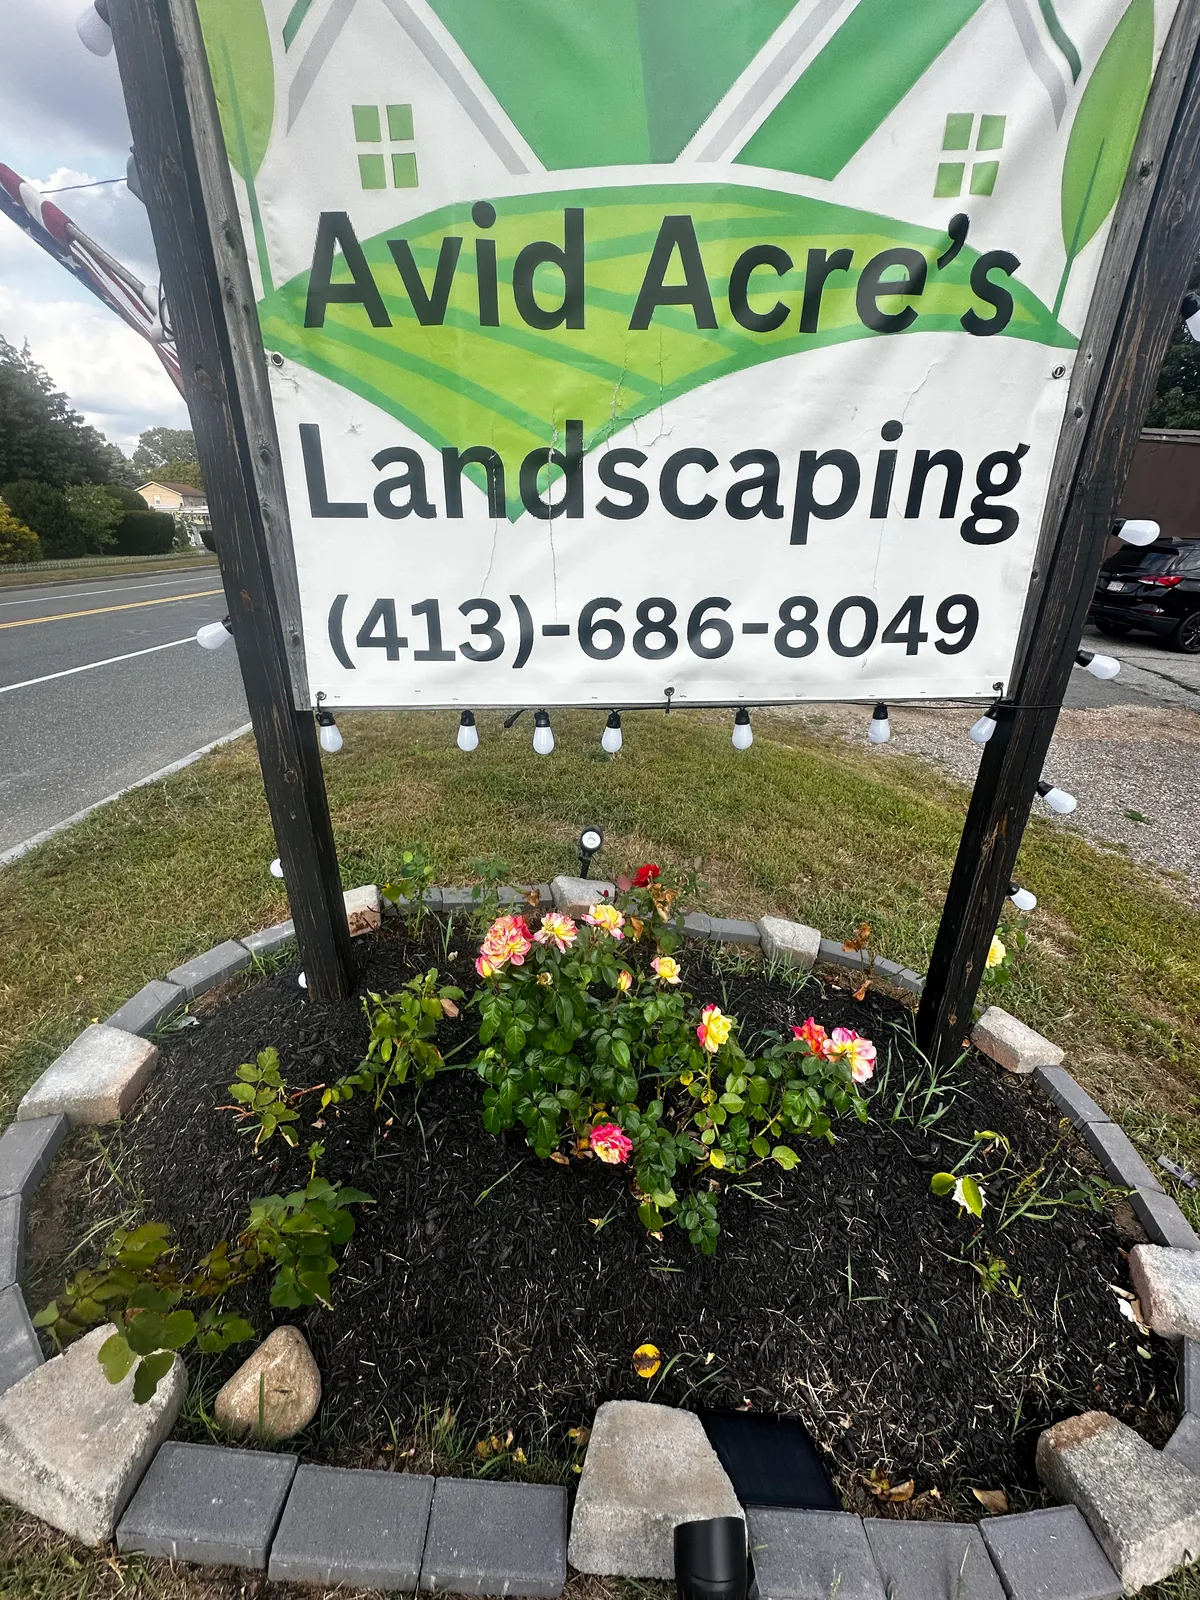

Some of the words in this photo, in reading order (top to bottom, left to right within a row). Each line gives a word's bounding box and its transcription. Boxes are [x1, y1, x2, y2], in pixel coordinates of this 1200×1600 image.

[304, 202, 585, 330] Avid
[628, 214, 1021, 337] Acre's
[299, 419, 1031, 545] Landscaping
[327, 593, 979, 671] (413)-686-8049
